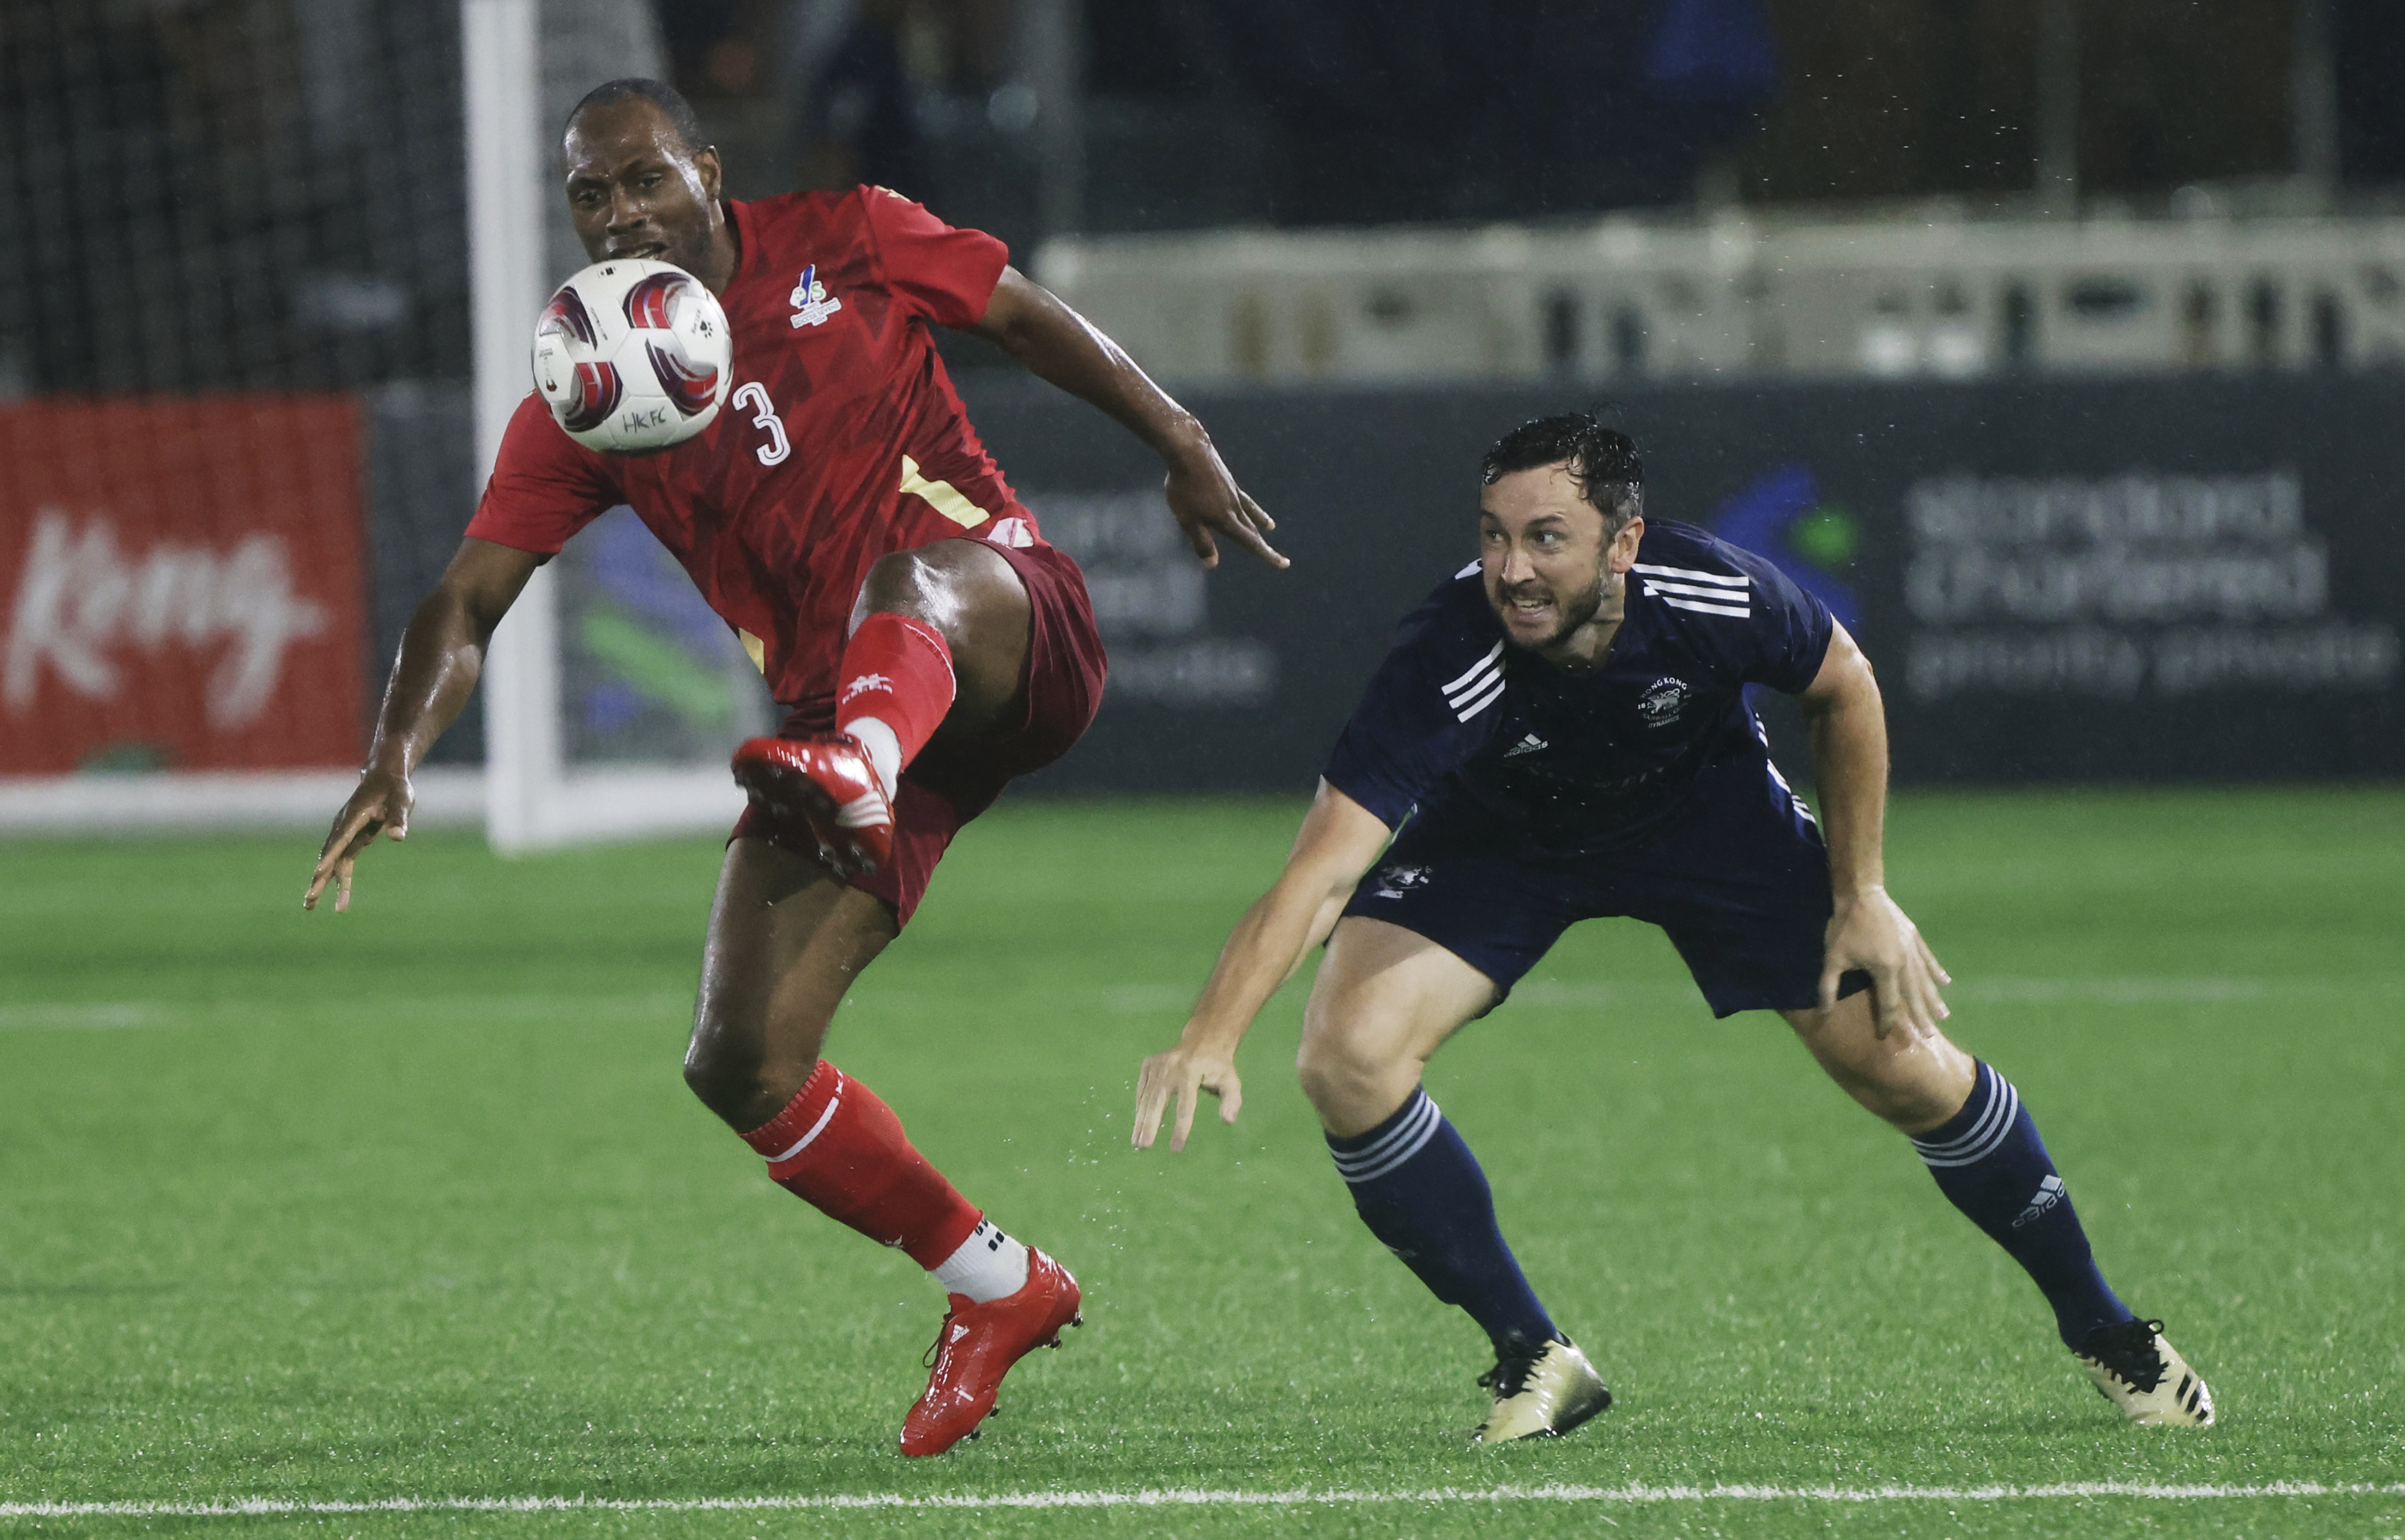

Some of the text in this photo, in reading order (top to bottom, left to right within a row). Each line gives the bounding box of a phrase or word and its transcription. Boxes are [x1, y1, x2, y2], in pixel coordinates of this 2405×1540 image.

[793, 304, 840, 327] SOCCER SEVENS
[622, 406, 667, 434] HKFC
[732, 382, 791, 466] 3
[1640, 677, 1687, 698] HONG KONG
[1648, 715, 1680, 728] DYNAMICS
[1503, 741, 1549, 758] adidas
